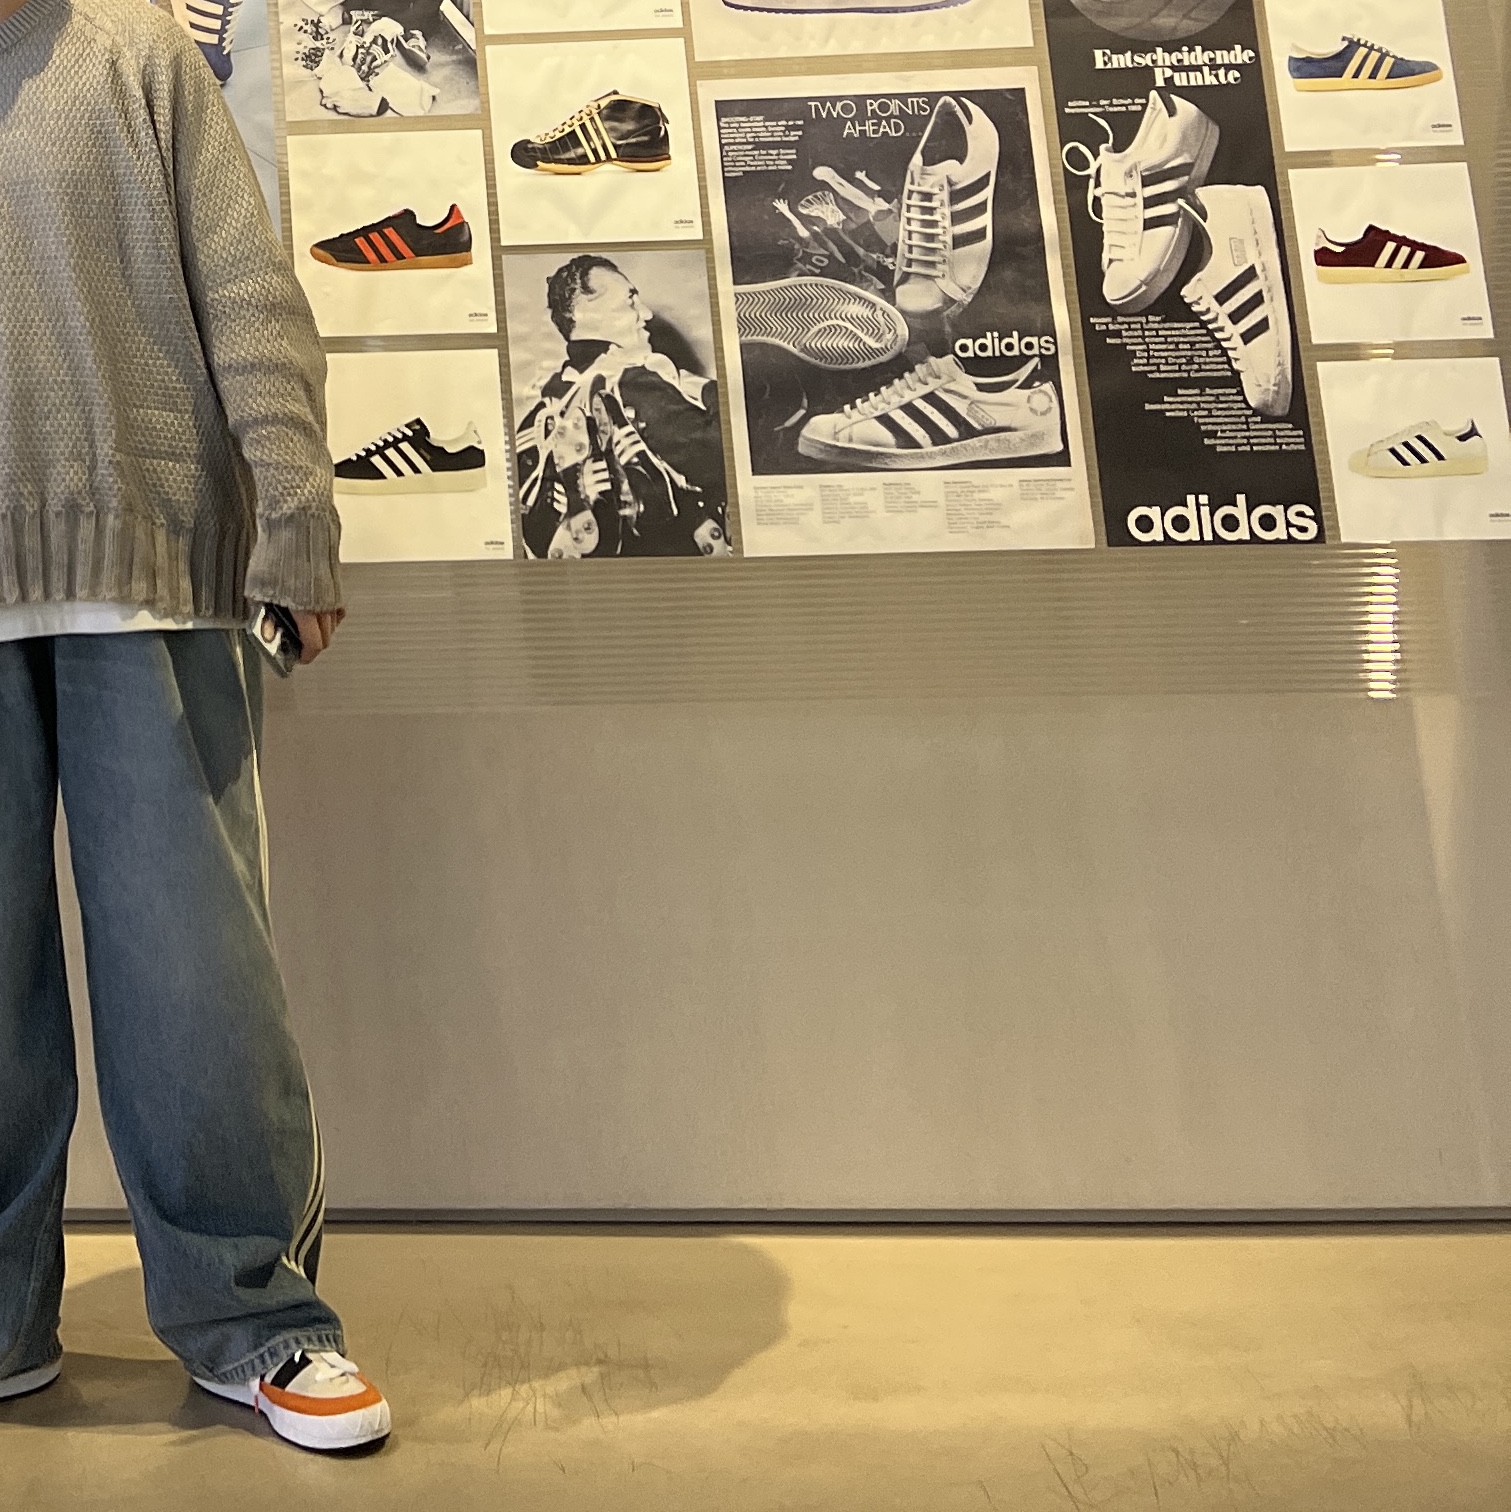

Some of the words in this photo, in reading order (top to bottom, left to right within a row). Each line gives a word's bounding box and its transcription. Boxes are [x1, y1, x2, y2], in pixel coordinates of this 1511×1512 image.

[1093, 44, 1256, 70] Entscheidende
[1153, 65, 1241, 88] Punkte
[807, 100, 856, 119] TWO
[867, 97, 931, 116] POINTS
[954, 330, 1056, 358] adidas
[1126, 493, 1318, 542] adidas
